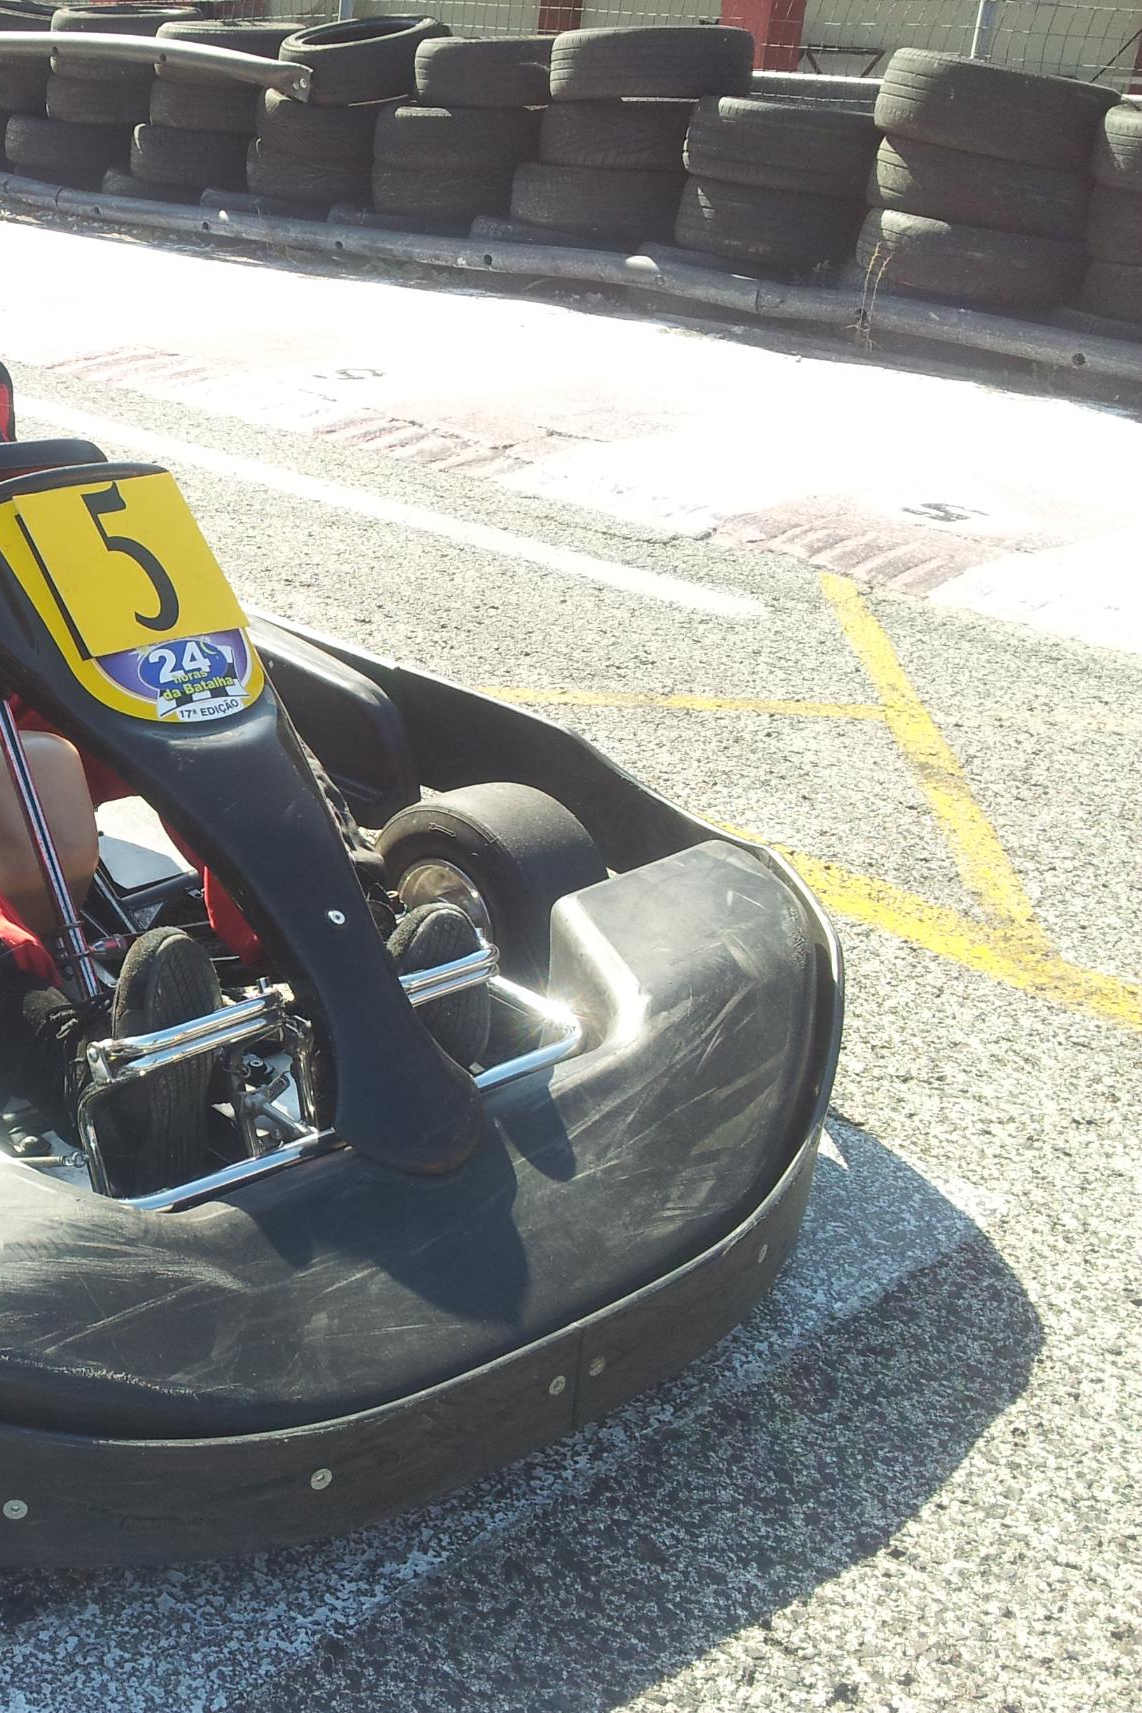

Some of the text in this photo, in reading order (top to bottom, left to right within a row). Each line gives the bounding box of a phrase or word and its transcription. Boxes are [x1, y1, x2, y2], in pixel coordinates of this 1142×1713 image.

[81, 480, 180, 632] 5
[148, 641, 212, 684] 24
[162, 675, 234, 701] da Batalha
[200, 698, 239, 717] EDIÇÃO
